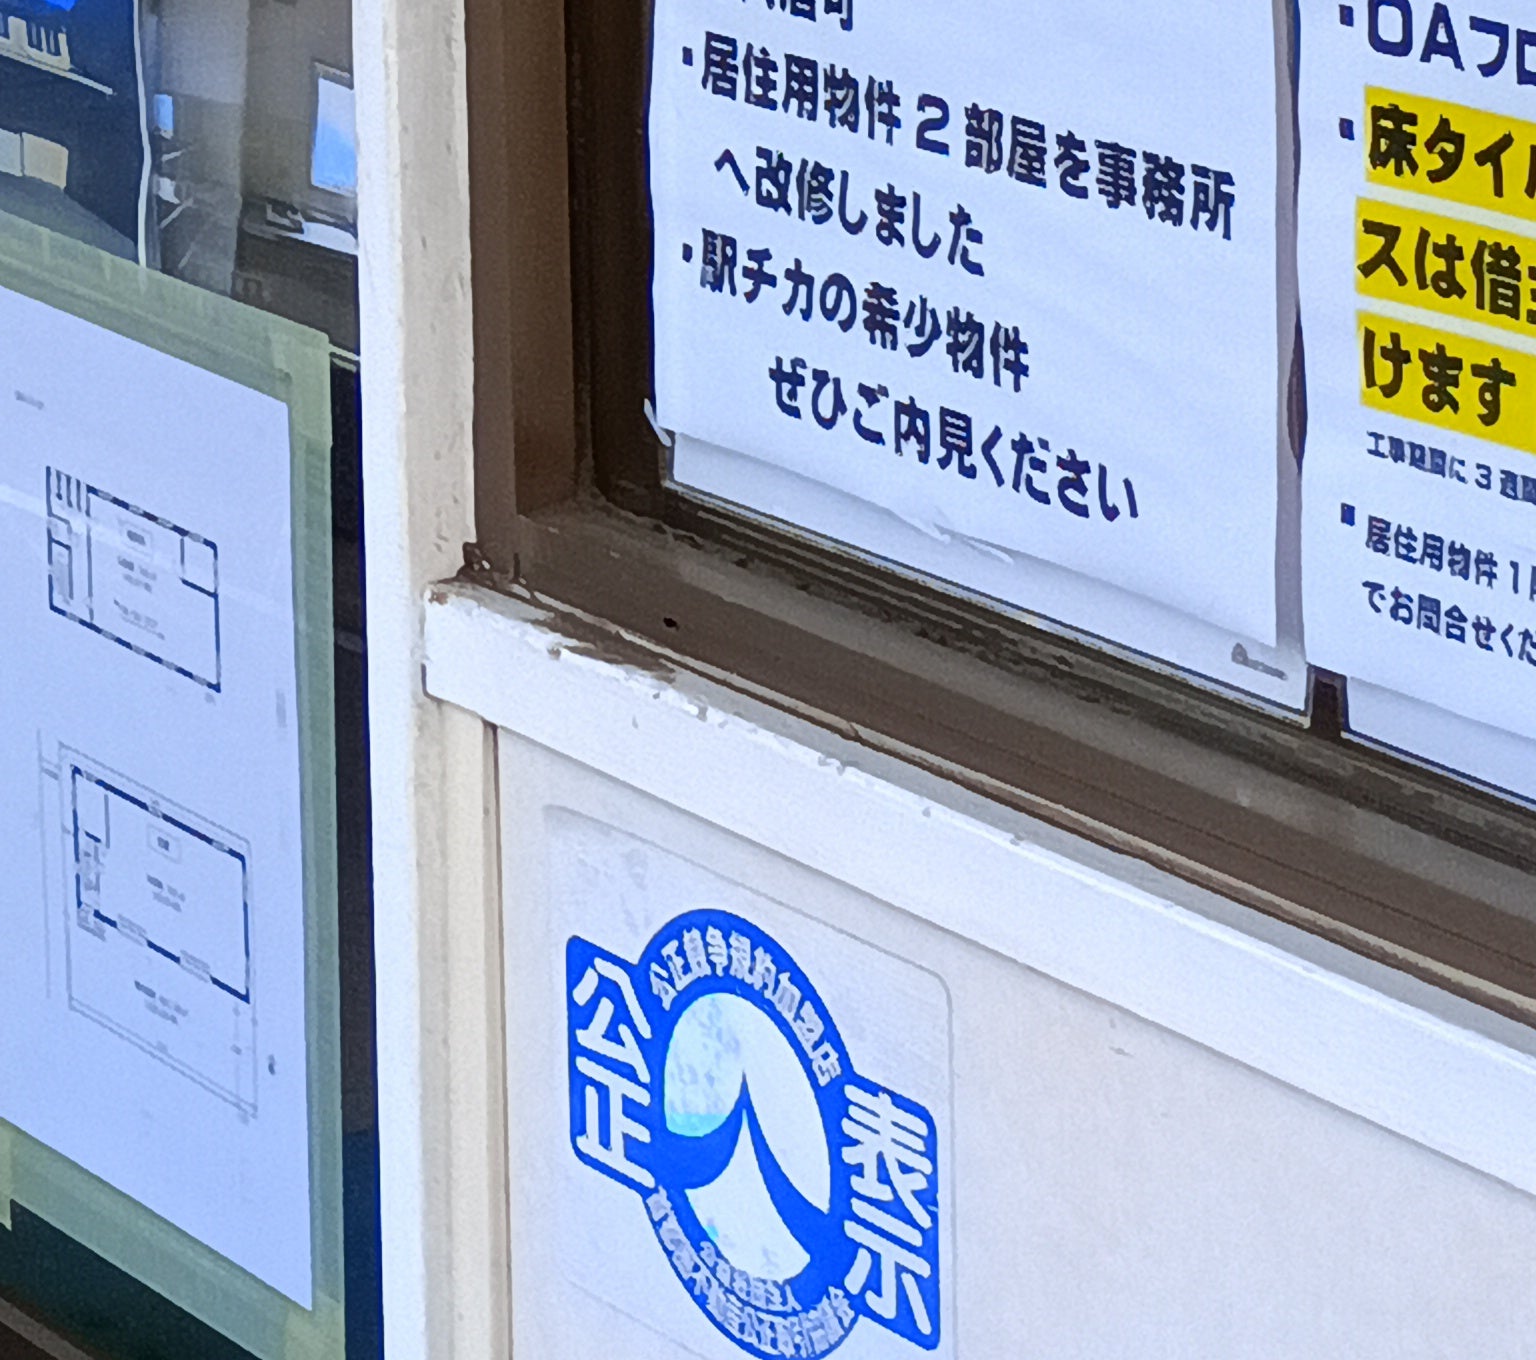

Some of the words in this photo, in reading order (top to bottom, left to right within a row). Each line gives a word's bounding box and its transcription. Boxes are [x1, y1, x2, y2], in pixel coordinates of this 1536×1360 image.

[1338, 102, 1536, 200] ・床タイ
[713, 145, 986, 278] へ改修しました
[1356, 218, 1536, 326] スは借
[1363, 325, 1518, 428] けます
[768, 354, 1140, 523] ぜひご内見ください
[1340, 501, 1536, 602] ・居住用物件1
[572, 956, 657, 1189] 公正
[840, 1082, 933, 1337] 表示
